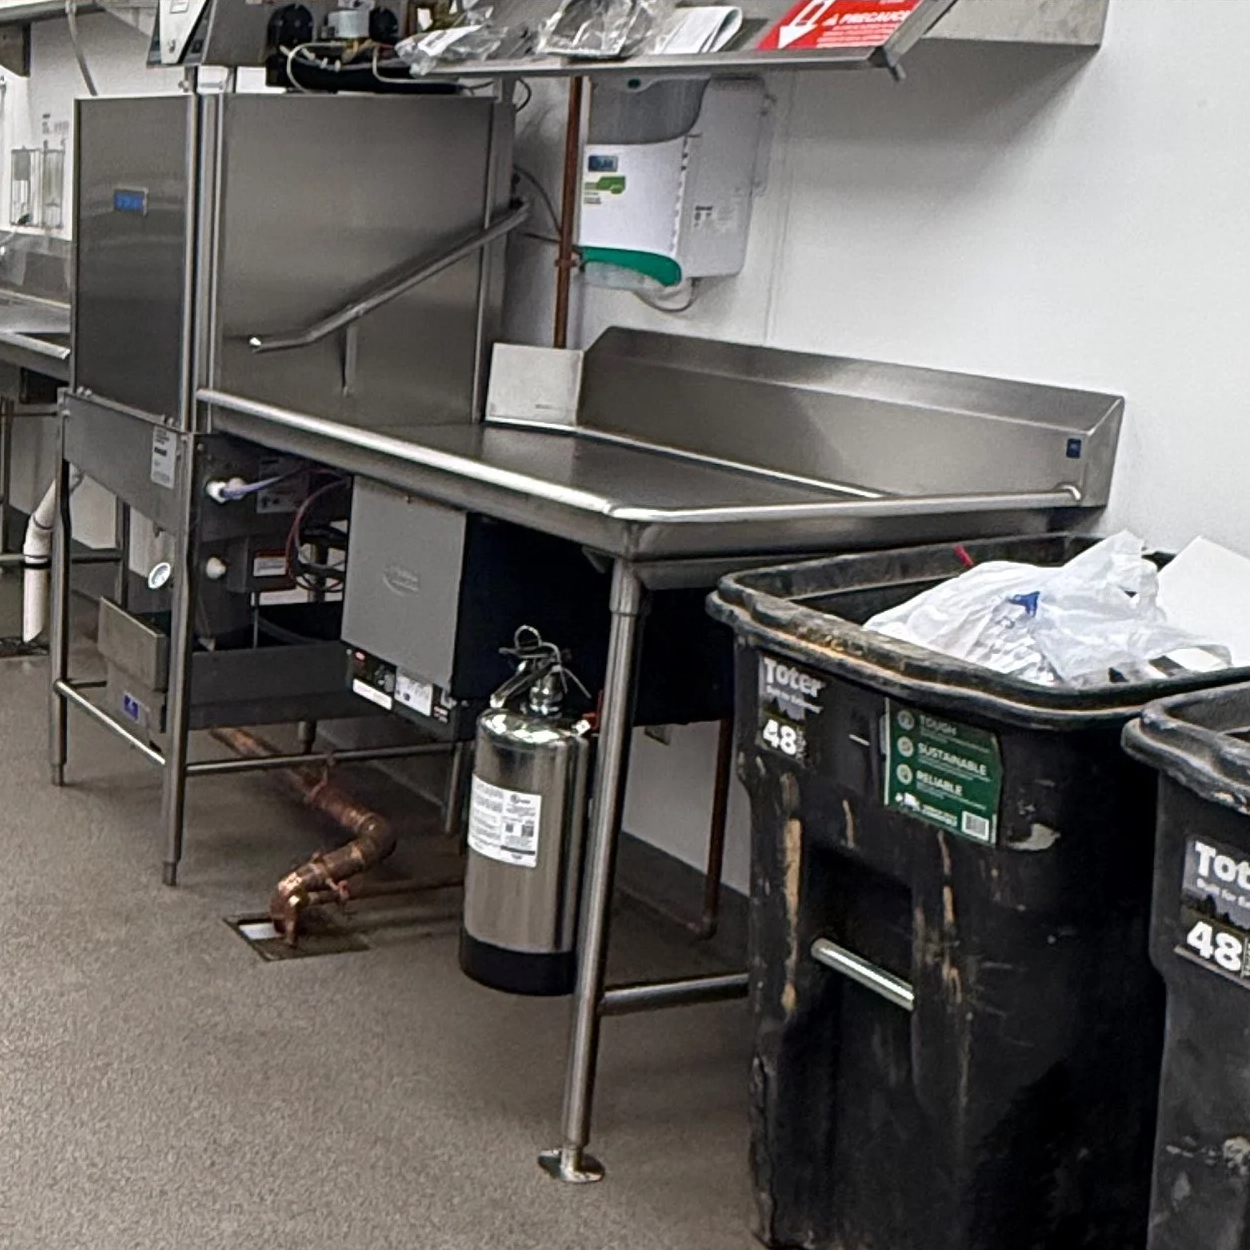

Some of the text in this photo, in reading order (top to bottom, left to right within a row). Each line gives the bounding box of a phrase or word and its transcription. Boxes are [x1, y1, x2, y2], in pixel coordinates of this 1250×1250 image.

[763, 657, 826, 698] Toter
[763, 718, 797, 755] 48
[917, 742, 987, 776] SUSTAINABLE
[916, 770, 963, 797] RELIABLE
[1187, 921, 1242, 971] 48
